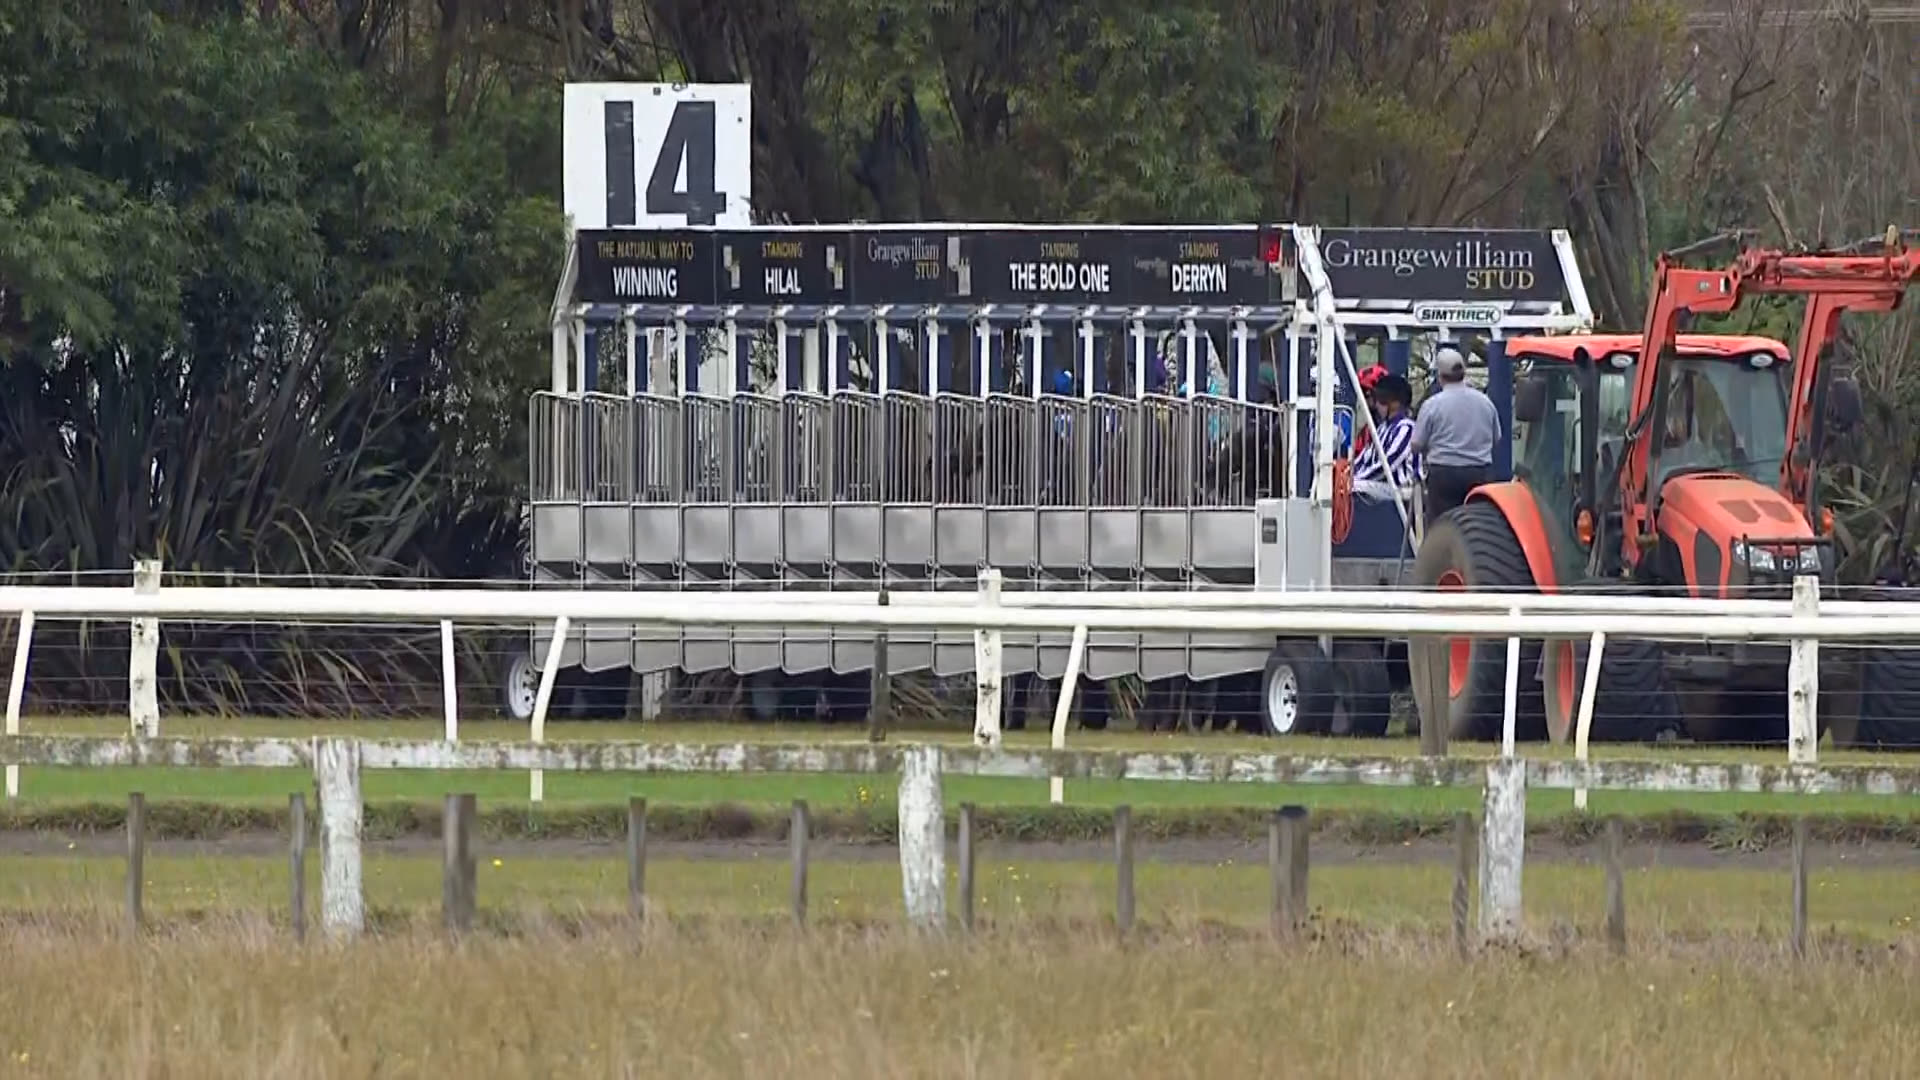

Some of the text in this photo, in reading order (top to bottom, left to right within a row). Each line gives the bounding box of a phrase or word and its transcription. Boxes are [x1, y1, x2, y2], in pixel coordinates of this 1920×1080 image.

[604, 100, 727, 226] 14
[598, 241, 694, 261] THE NATURAL WAY TO
[762, 242, 803, 258] STANDING
[867, 237, 939, 268] Grangewilliam
[1040, 242, 1079, 258] STANDING
[1179, 243, 1219, 258] STANDING
[1325, 239, 1533, 275] Grangewilliam
[613, 267, 677, 297] WINNING
[765, 267, 802, 294] HILAL
[915, 263, 940, 280] STUD
[1009, 263, 1037, 290] THE
[1040, 263, 1076, 291] BOLD
[1080, 263, 1110, 292] ONE
[1171, 264, 1227, 293] DERRYN
[1465, 270, 1534, 290] STUD
[1421, 308, 1496, 321] SIMTRACK
